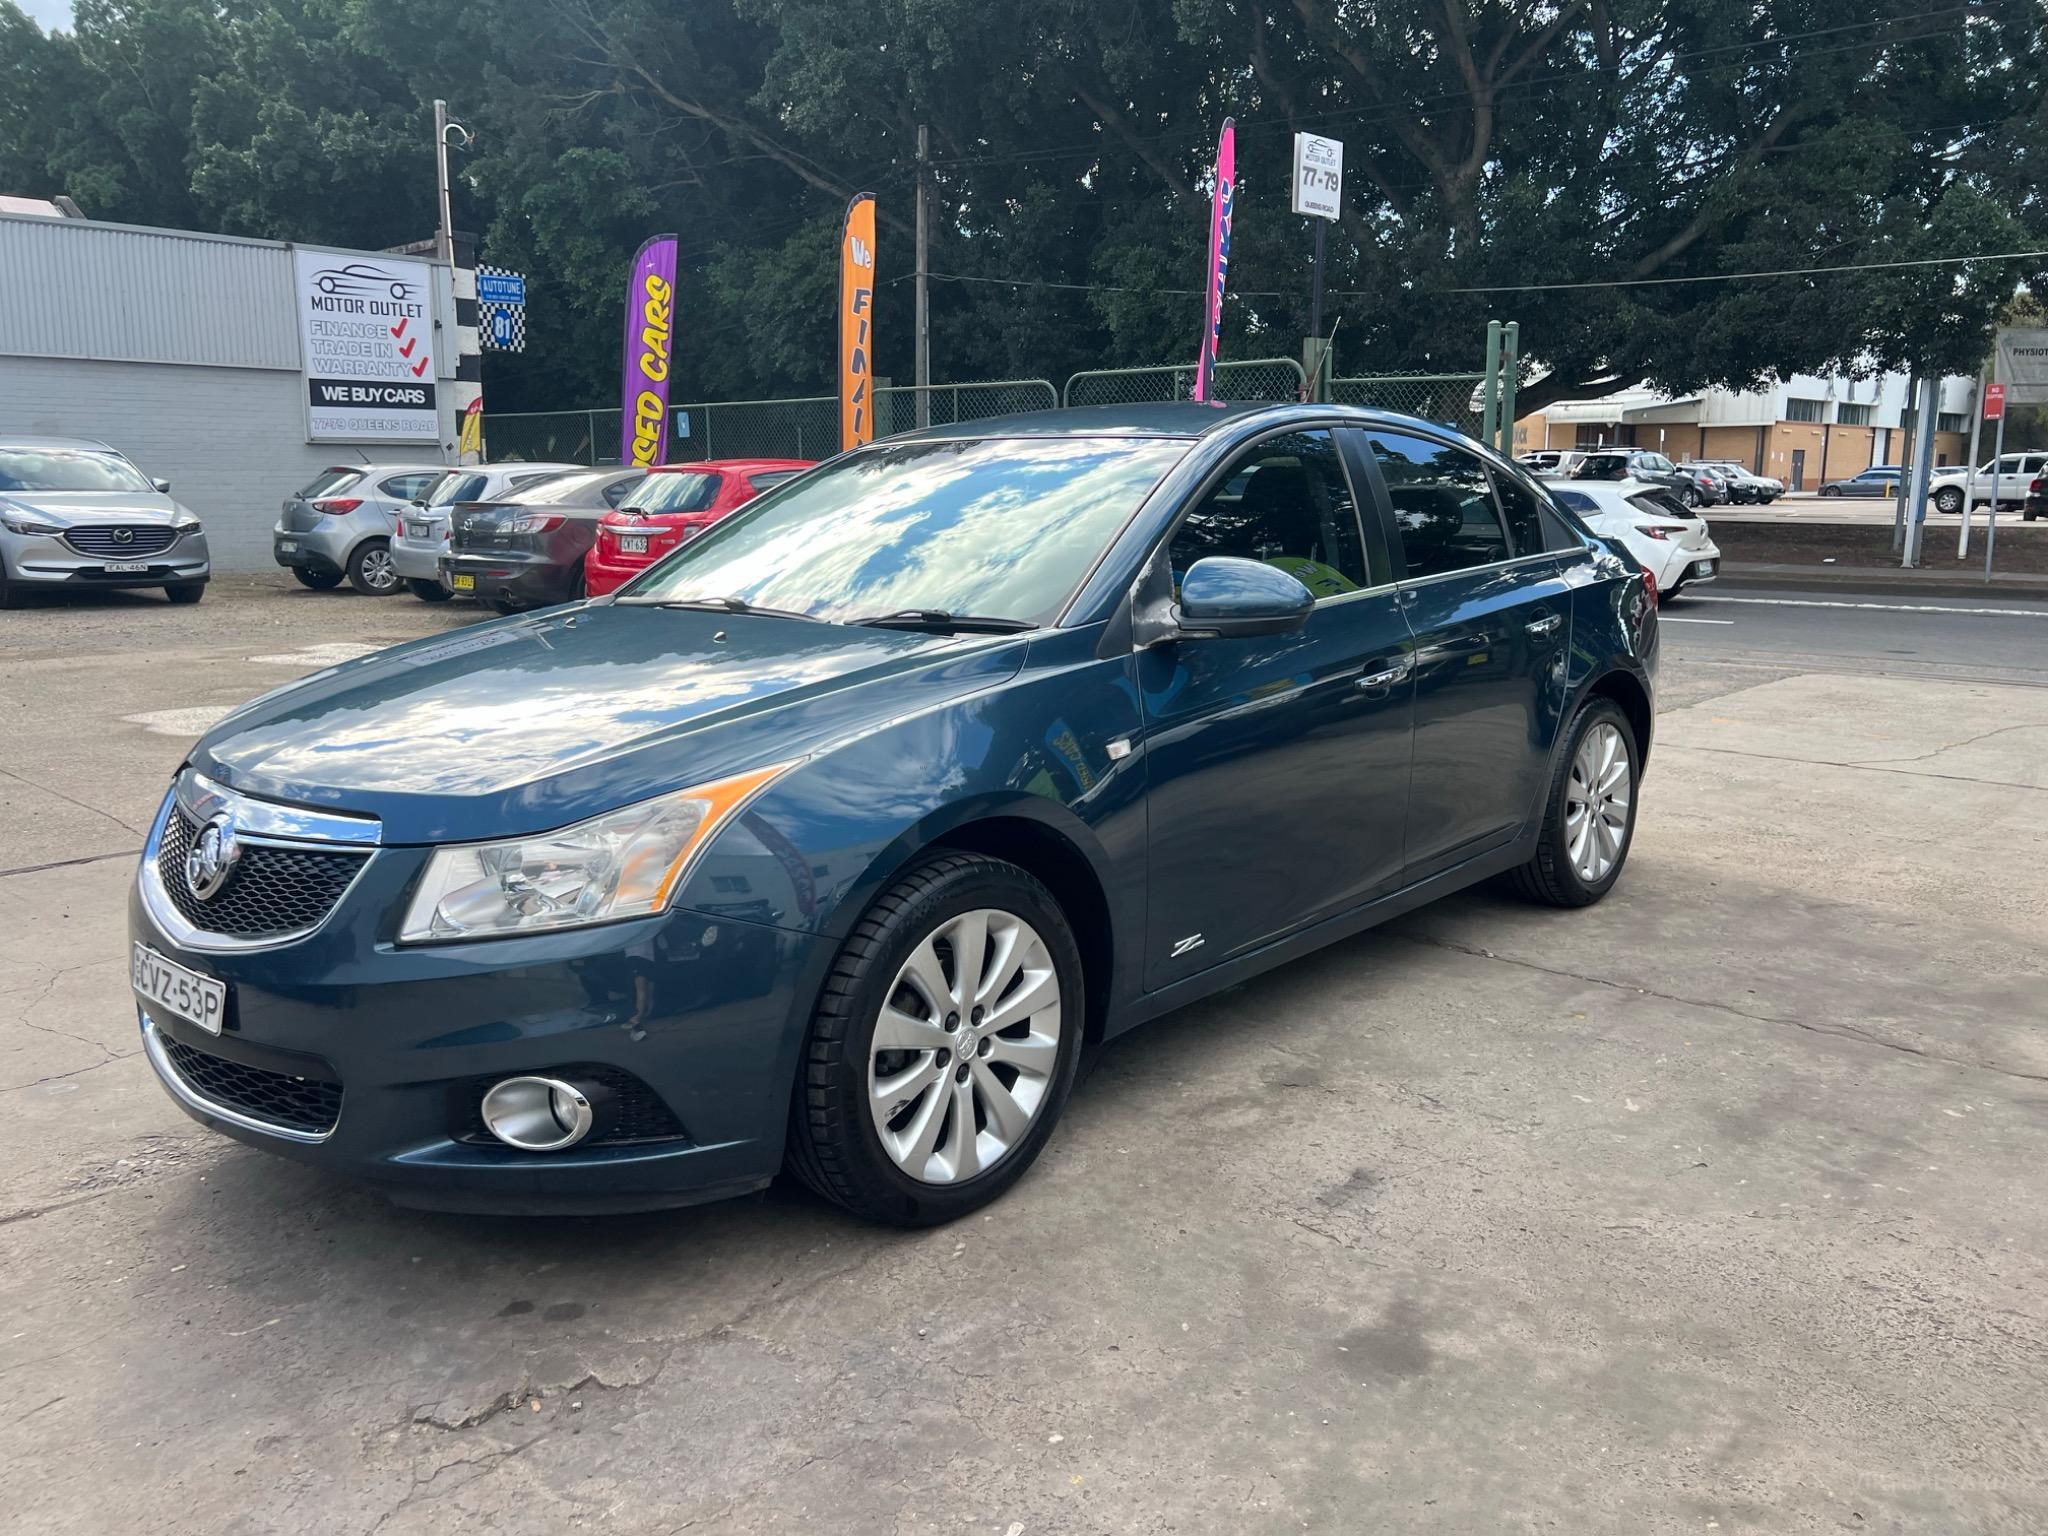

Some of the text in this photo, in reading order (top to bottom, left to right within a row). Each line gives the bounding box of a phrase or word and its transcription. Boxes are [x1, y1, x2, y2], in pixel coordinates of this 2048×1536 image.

[850, 236, 872, 268] We
[483, 280, 521, 295] AUTOTUNE
[311, 296, 423, 318] MOTOR OUTLET
[310, 320, 388, 339] FINANCE
[495, 316, 511, 339] 81
[311, 339, 393, 358] TRADE IN
[312, 358, 413, 377] WARRANTY
[631, 273, 673, 467] SED CARS
[321, 386, 426, 404] WE BUY CARS
[348, 418, 400, 431] QUEENS
[401, 420, 438, 432] ROAD
